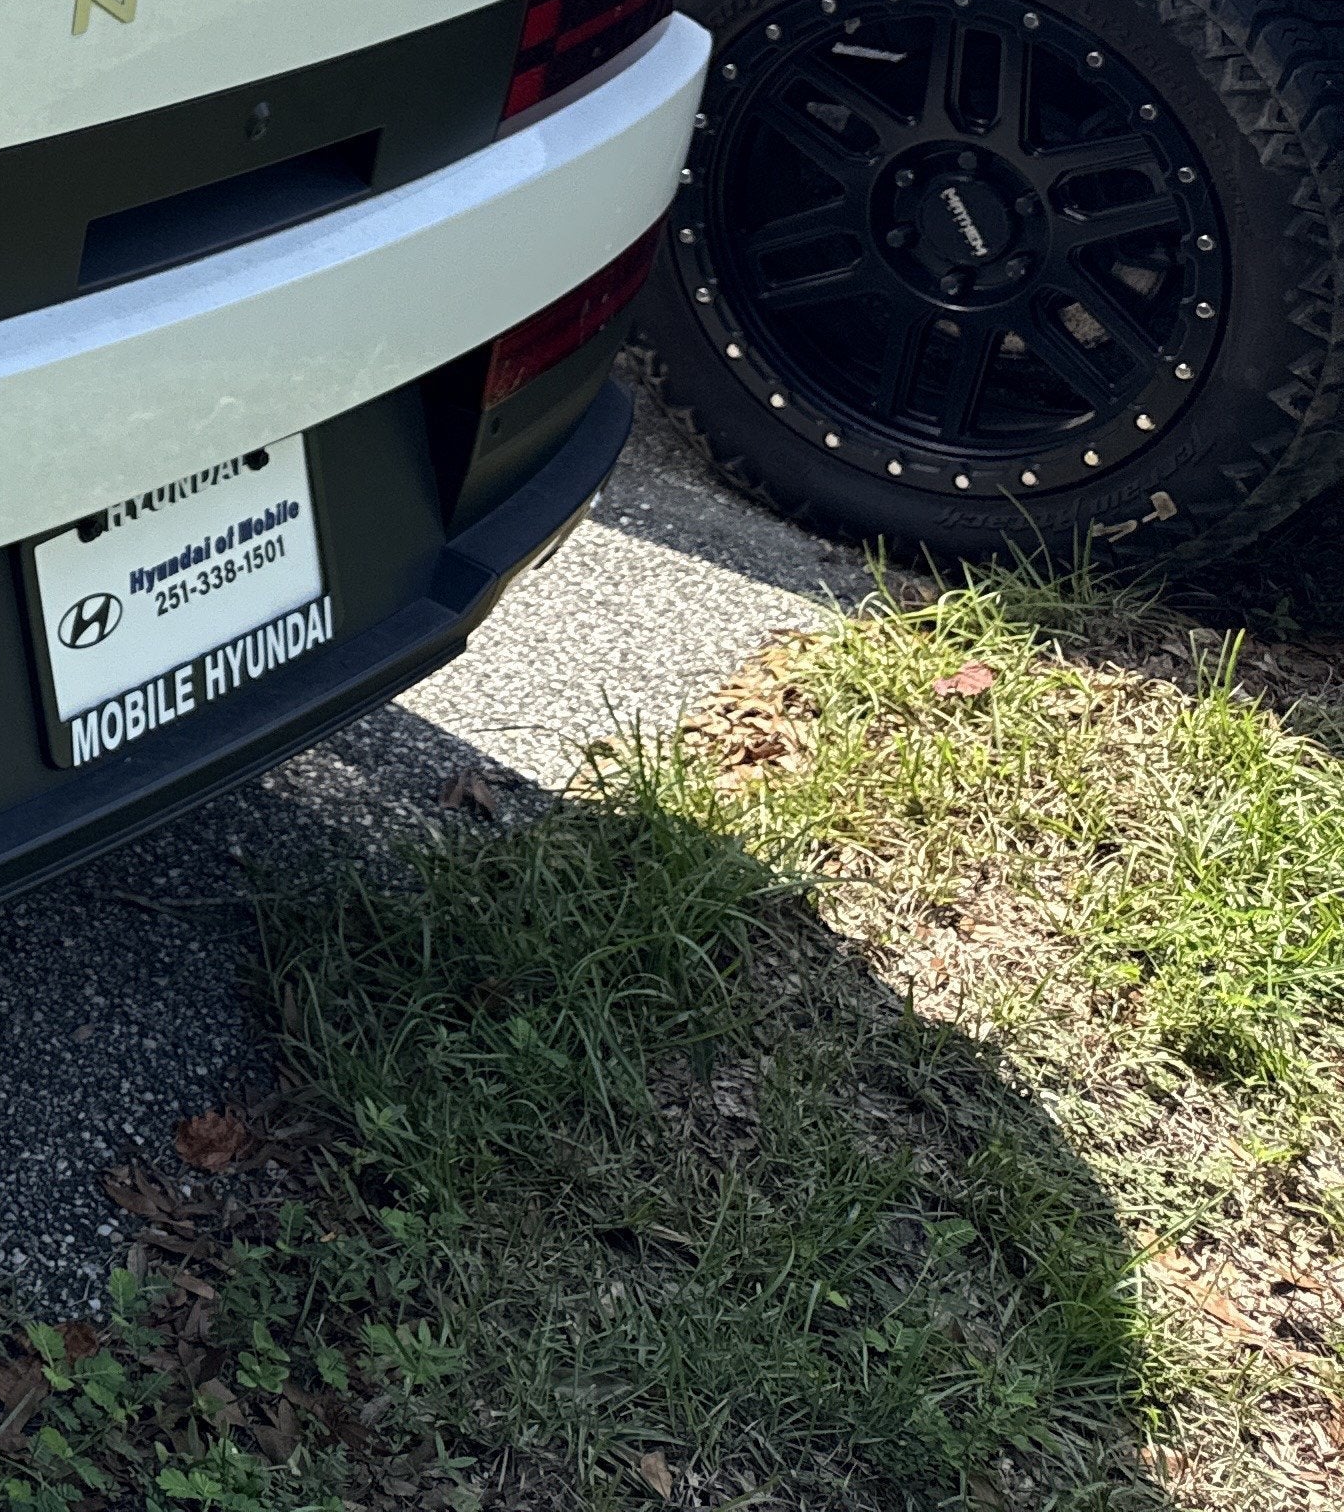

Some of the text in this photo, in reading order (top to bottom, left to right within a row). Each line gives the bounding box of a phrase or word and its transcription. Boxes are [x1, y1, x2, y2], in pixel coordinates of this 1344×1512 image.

[129, 499, 300, 595] Hyundai of Mobile
[155, 534, 285, 617] 251-338-1501
[70, 595, 334, 767] MOBILE HYUNDAI
